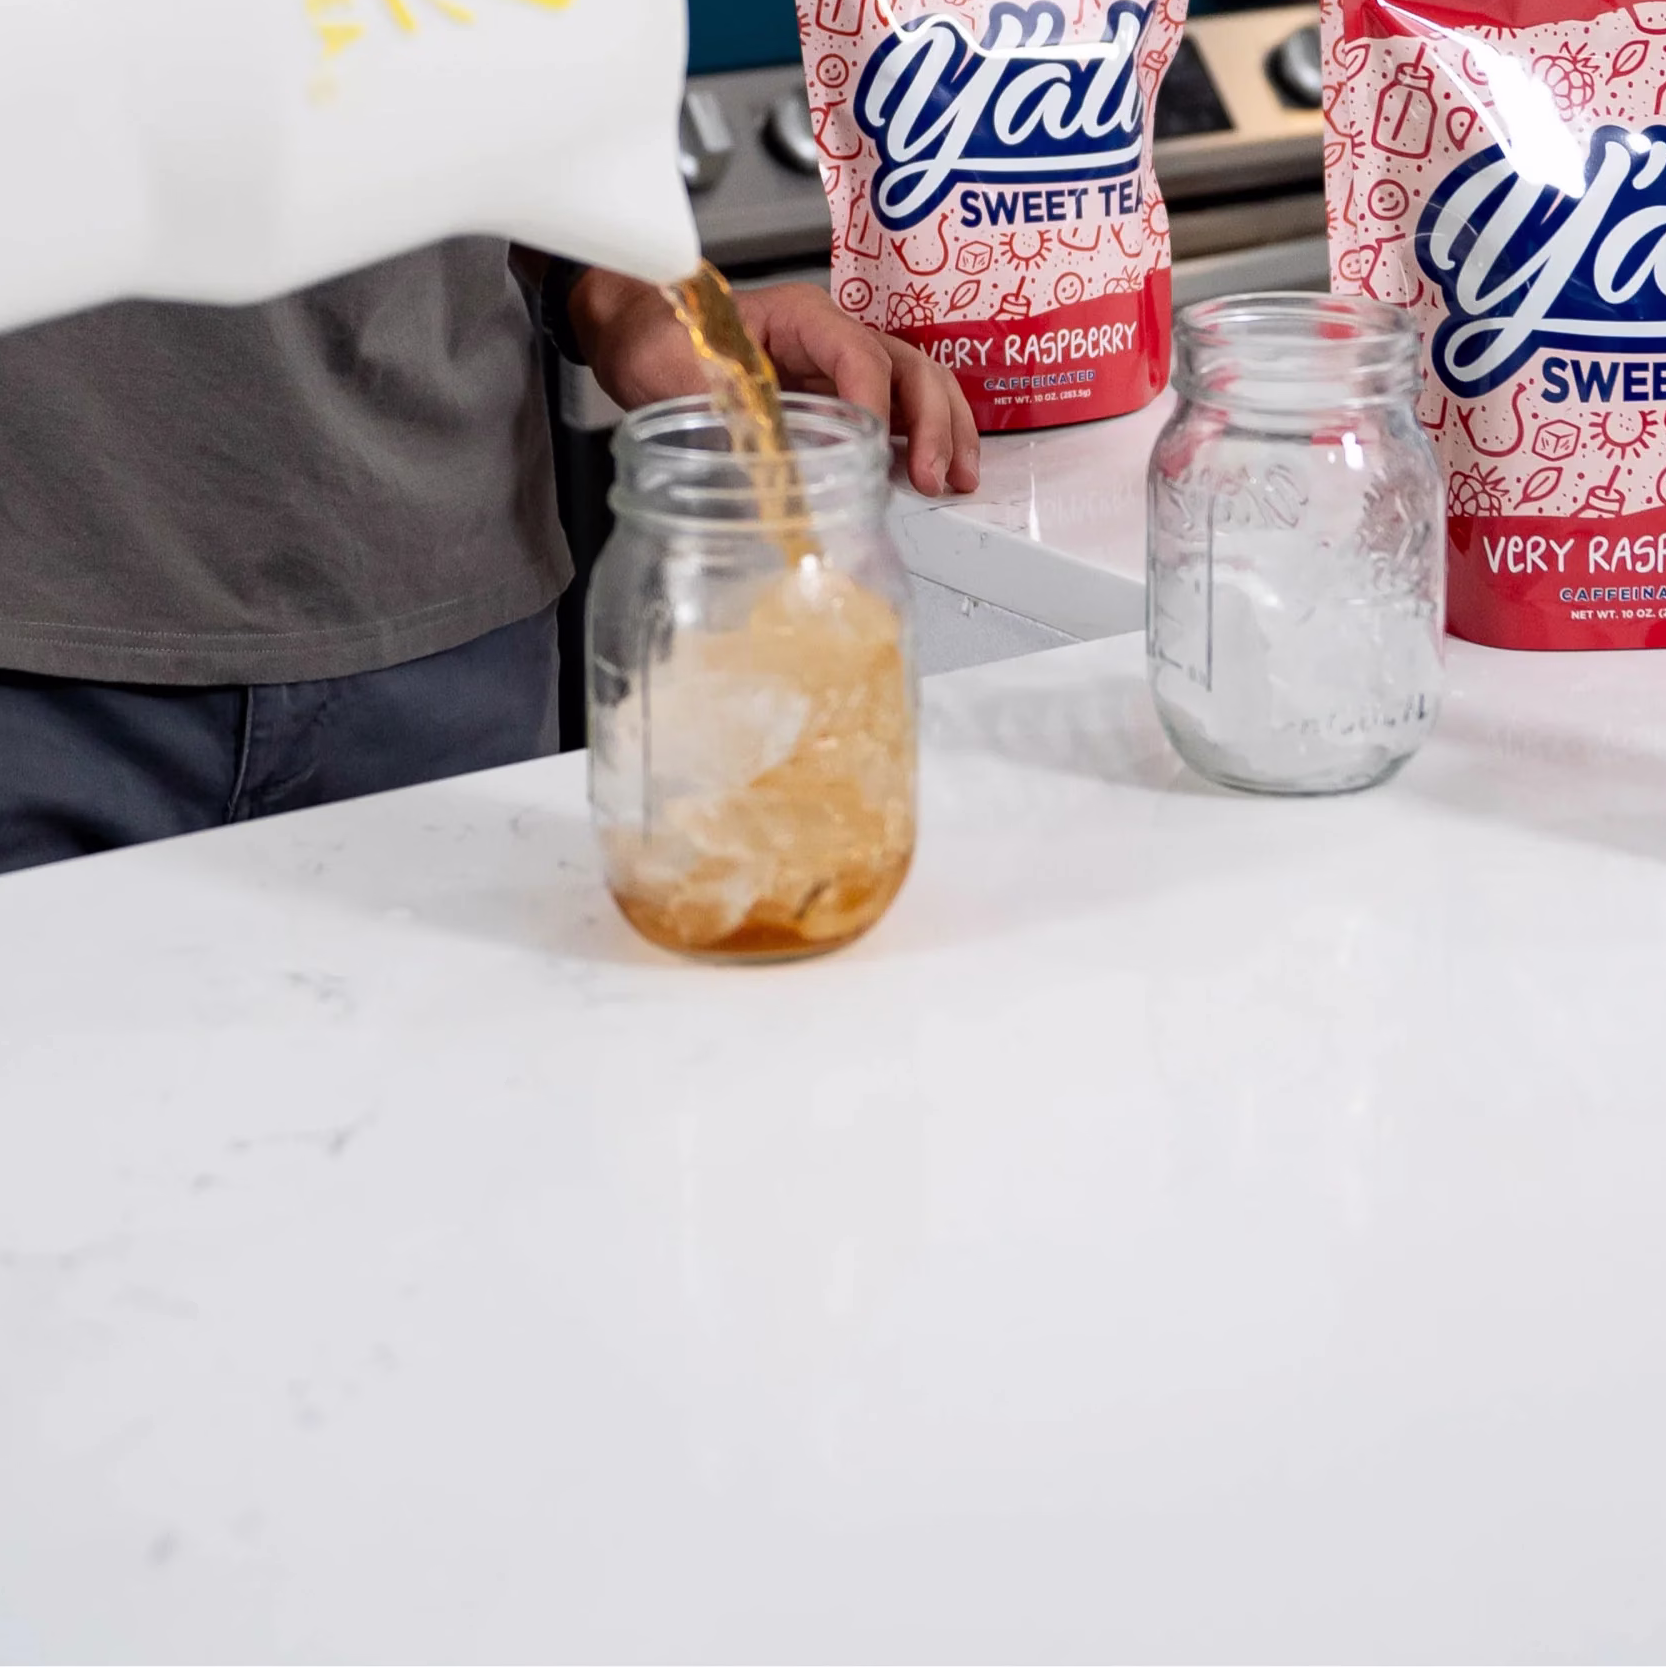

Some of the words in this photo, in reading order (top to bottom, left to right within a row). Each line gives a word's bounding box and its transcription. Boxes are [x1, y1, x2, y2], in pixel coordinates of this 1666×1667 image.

[960, 187, 1089, 228] SWEET
[983, 368, 1096, 391] CAFFEINATED
[994, 396, 1013, 406] NET
[1014, 395, 1032, 405] WT.
[1034, 394, 1044, 403] 10
[1044, 392, 1059, 402] OZ.
[1571, 610, 1593, 620] NET
[1596, 609, 1619, 619] WT.
[1621, 609, 1634, 618] 10
[1636, 608, 1656, 618] OZ.
